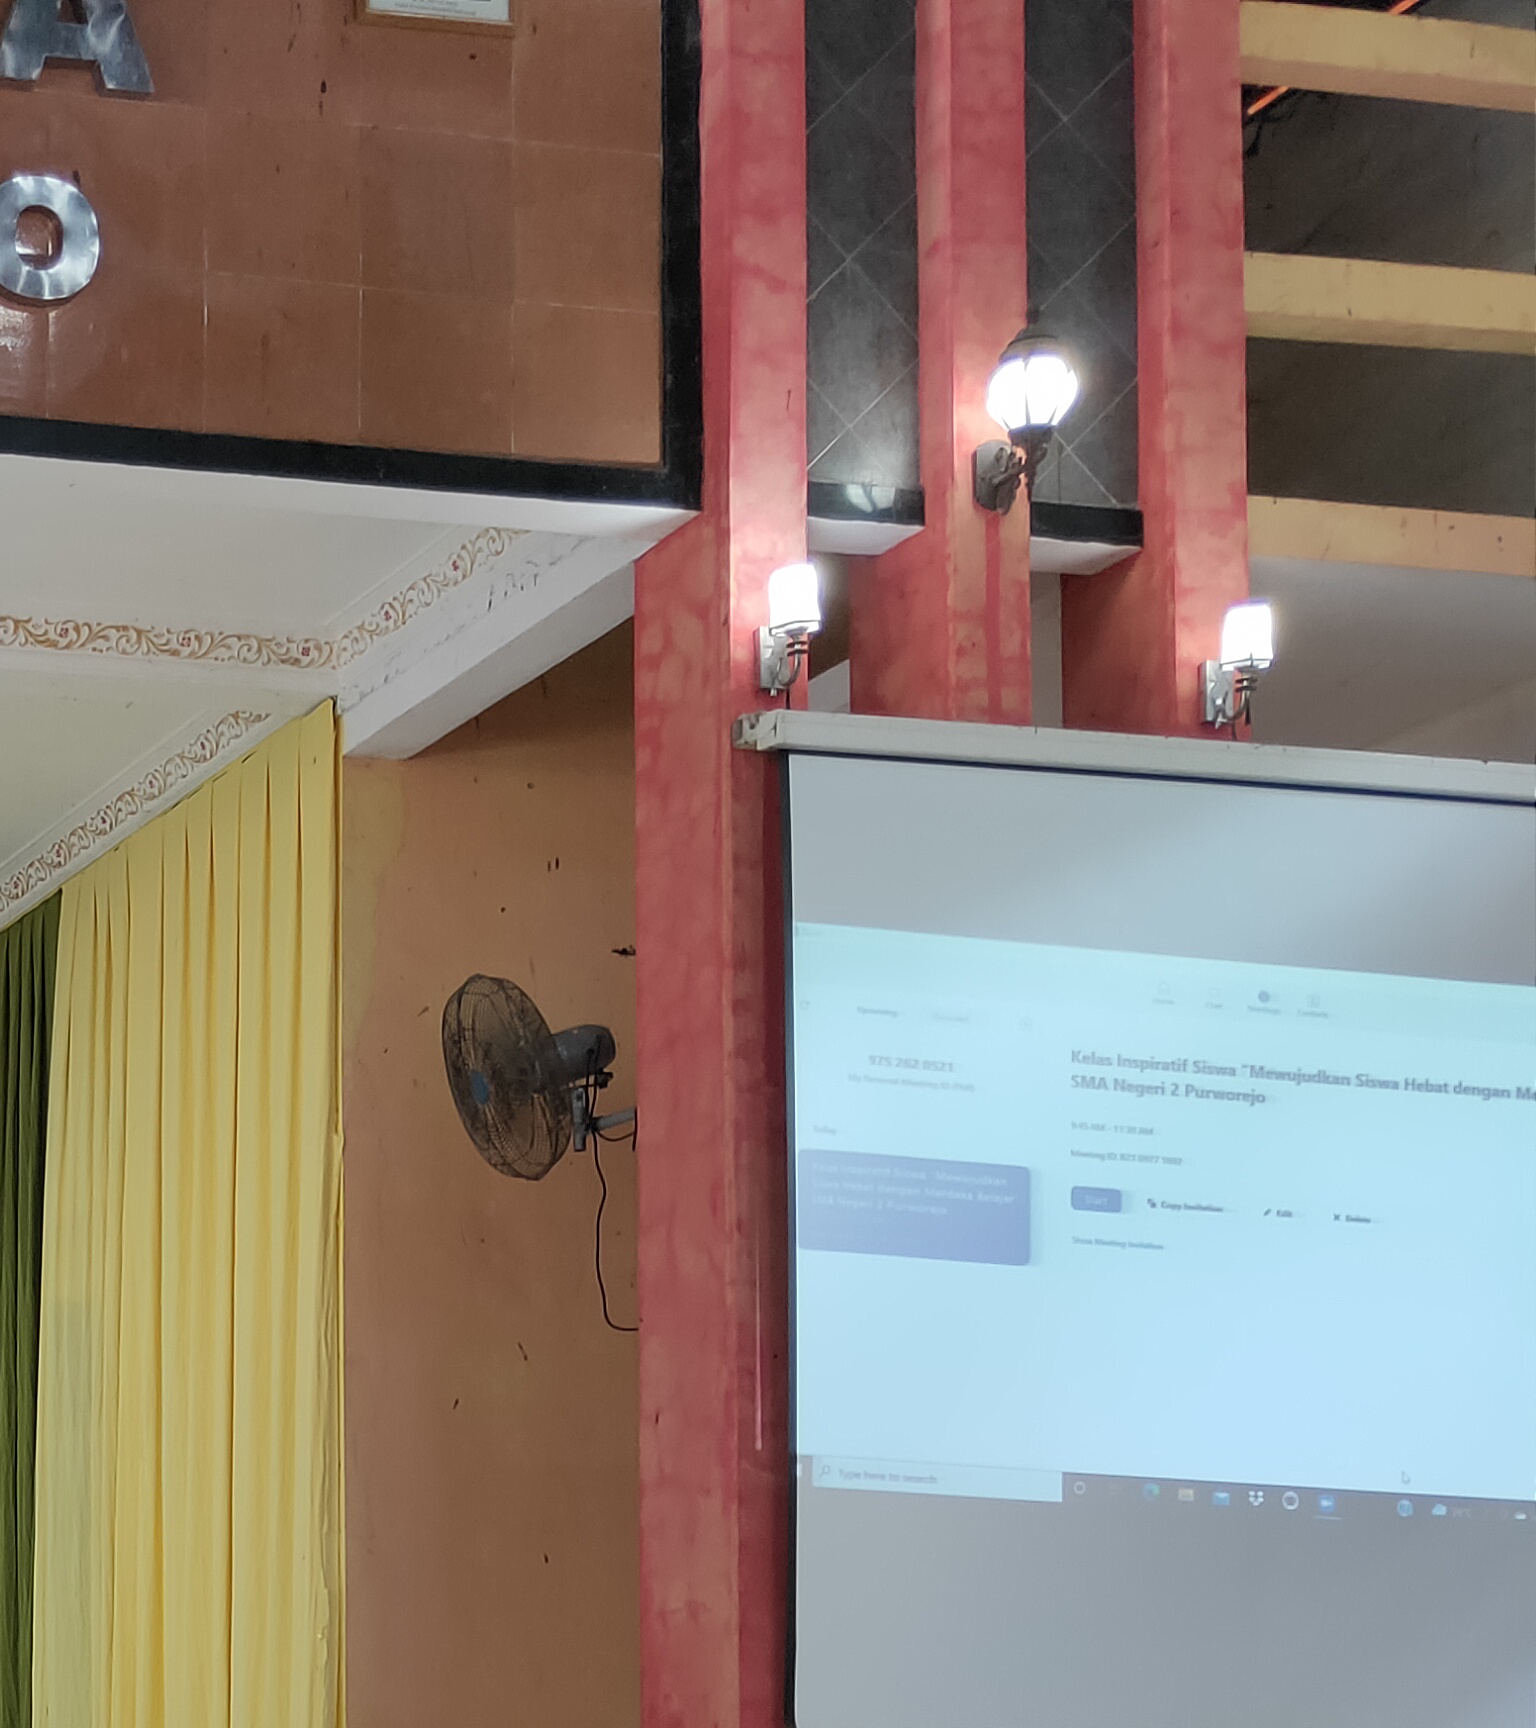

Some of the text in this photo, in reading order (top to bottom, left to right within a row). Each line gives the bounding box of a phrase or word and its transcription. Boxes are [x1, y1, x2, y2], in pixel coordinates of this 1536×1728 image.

[1070, 1074, 1267, 1107] SMA Negeri 2 Purworejo
[1071, 1049, 1114, 1067] Kelas
[1116, 1053, 1189, 1073] Inspiratif
[1192, 1060, 1237, 1077] Siswa
[1355, 1073, 1400, 1091] Siswa
[1404, 1077, 1450, 1095] Hebat
[1453, 1081, 1511, 1101] dengan
